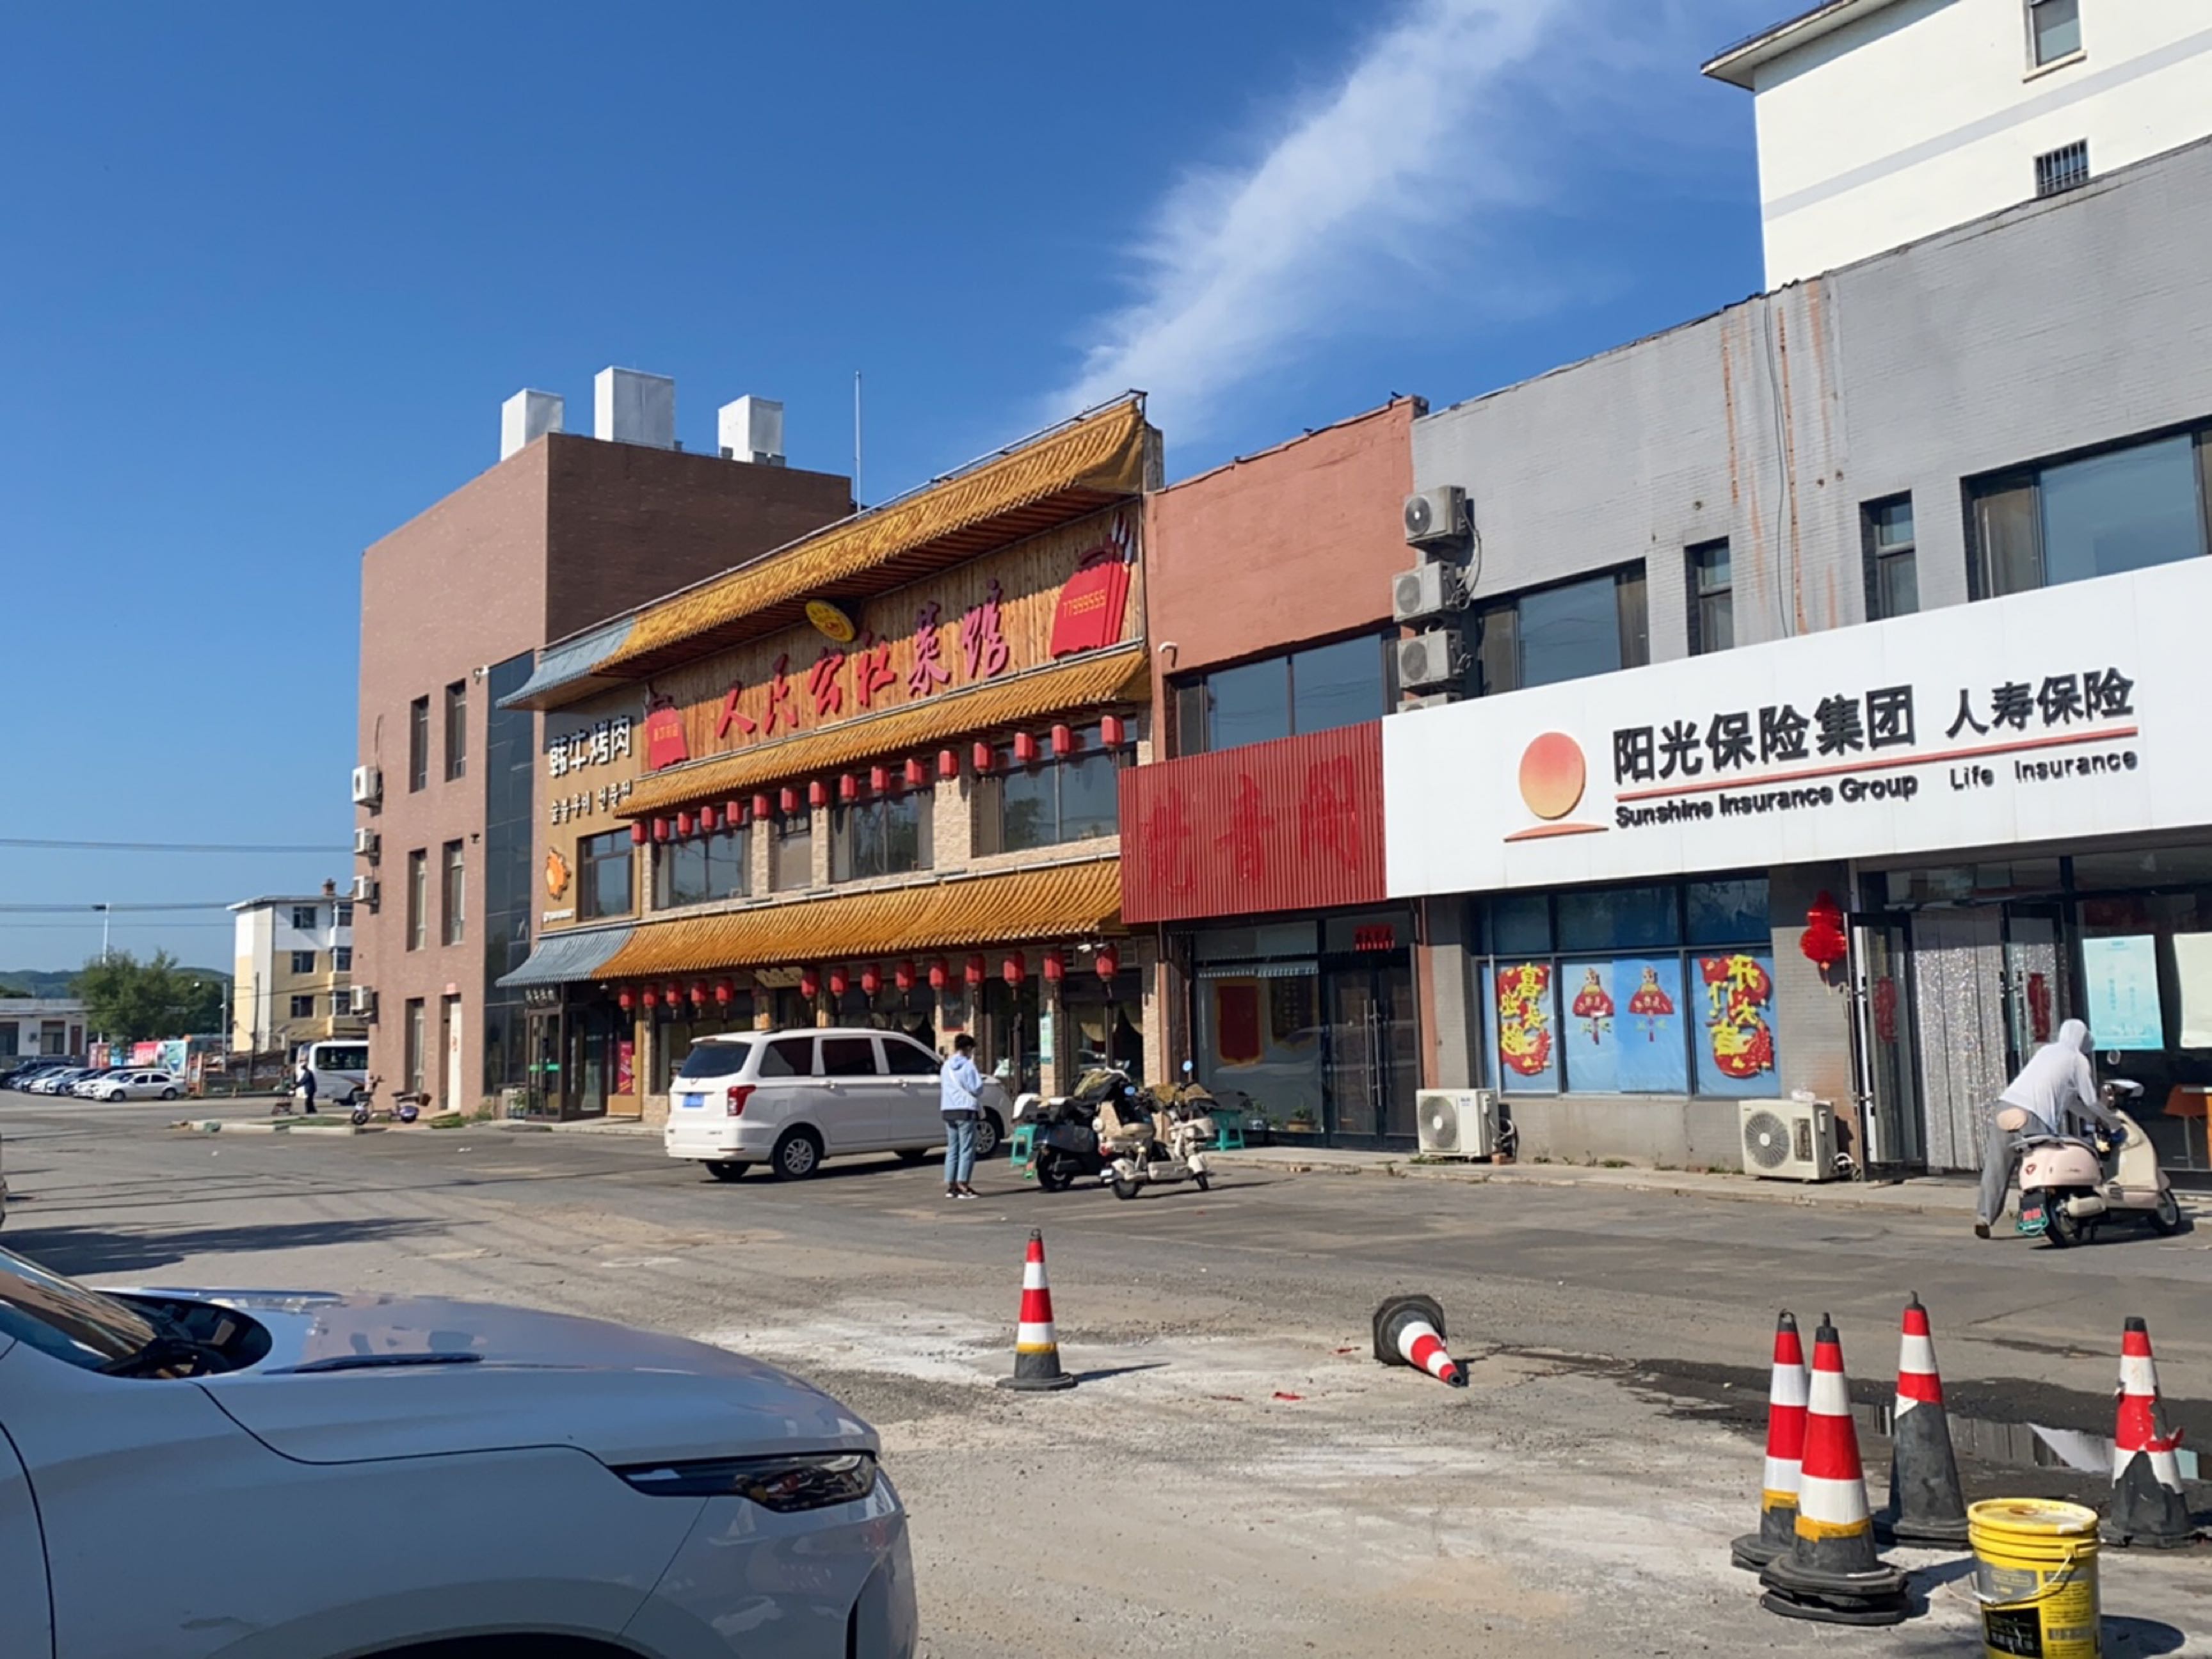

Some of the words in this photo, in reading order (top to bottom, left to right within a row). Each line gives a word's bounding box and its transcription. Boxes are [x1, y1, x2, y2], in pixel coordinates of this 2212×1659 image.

[1612, 684, 1916, 785] 阳光保险集团
[1945, 667, 2135, 739] 人寿保险
[1615, 798, 1713, 829] Sunshine
[1719, 784, 1834, 817] Insurance
[1839, 773, 1918, 803] Group
[1950, 765, 1994, 791] Life
[2014, 750, 2138, 783] Insurance
